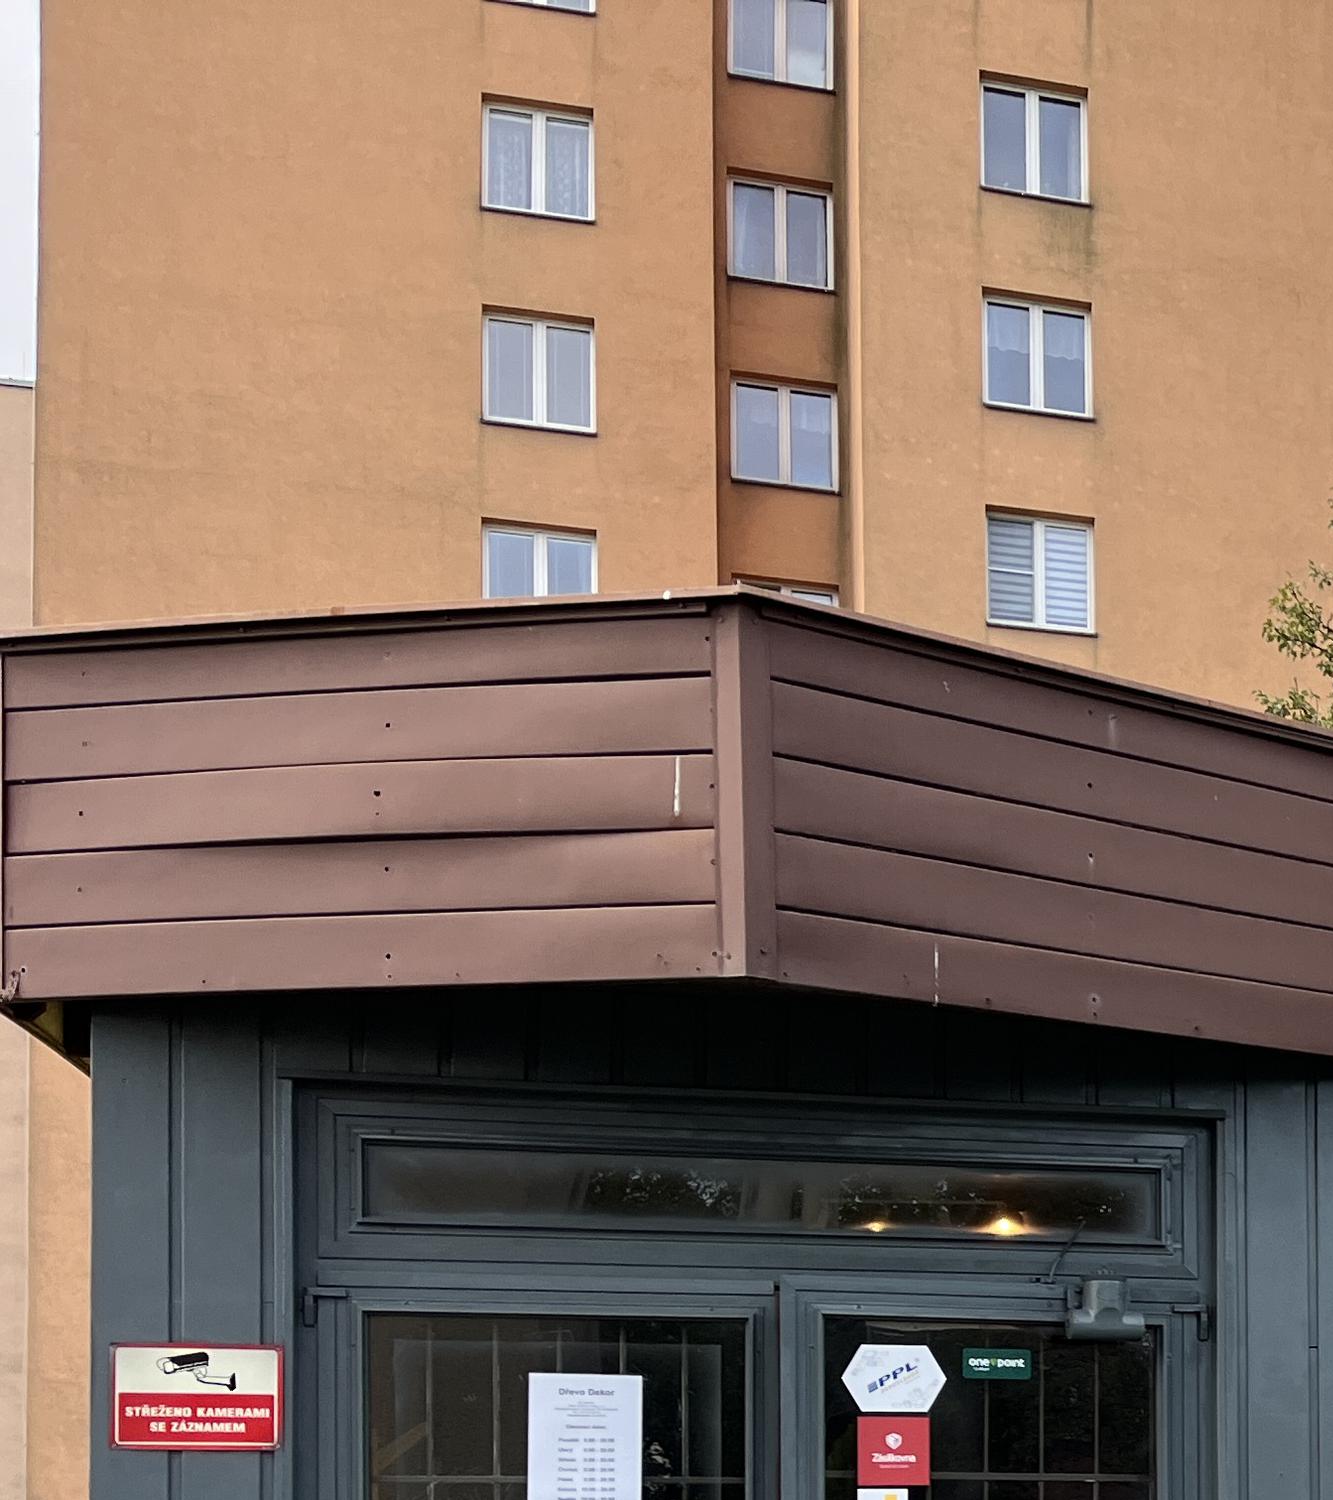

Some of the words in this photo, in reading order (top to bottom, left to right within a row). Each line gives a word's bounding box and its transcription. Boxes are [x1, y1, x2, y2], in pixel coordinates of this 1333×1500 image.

[878, 1362, 918, 1387] PPL
[124, 1404, 193, 1419] STŘEŽENO
[196, 1406, 271, 1418] KAMERAMI
[150, 1421, 166, 1432] SE
[170, 1419, 246, 1433] ZÁZNAMEM
